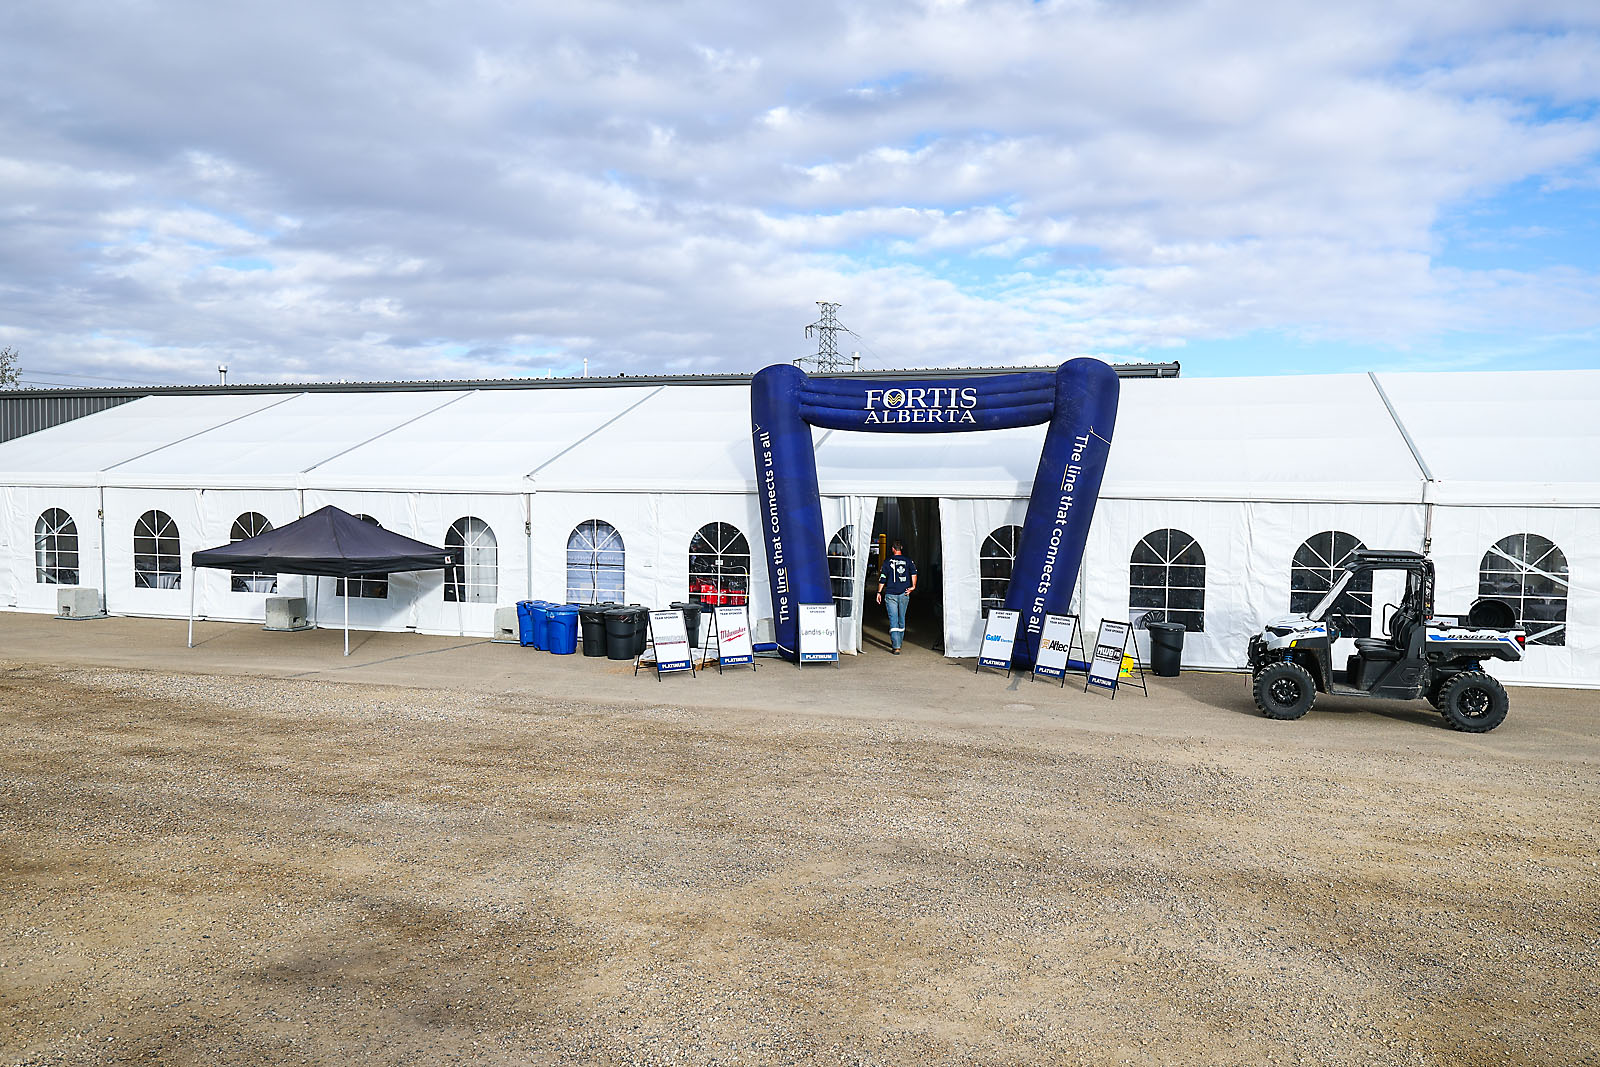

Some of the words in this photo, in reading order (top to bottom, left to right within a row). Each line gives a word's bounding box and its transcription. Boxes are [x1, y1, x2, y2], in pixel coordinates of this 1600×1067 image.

[864, 387, 977, 410] FORTIS
[864, 409, 977, 424] ALBERTA
[759, 431, 771, 448] all
[1071, 434, 1090, 462] The
[763, 450, 773, 467] us
[1063, 465, 1082, 492] line
[765, 469, 780, 534] connects
[1056, 495, 1073, 526] that
[772, 535, 785, 565] that
[1038, 528, 1063, 595] connects
[776, 567, 787, 594] line
[779, 596, 790, 624] The
[1032, 597, 1046, 614] us
[1027, 617, 1041, 634] all
[1048, 639, 1068, 653] Altec
[983, 659, 1006, 667] PLATINUM
[1038, 667, 1061, 676] PLATINUM
[1091, 677, 1112, 686] PLATINUM
